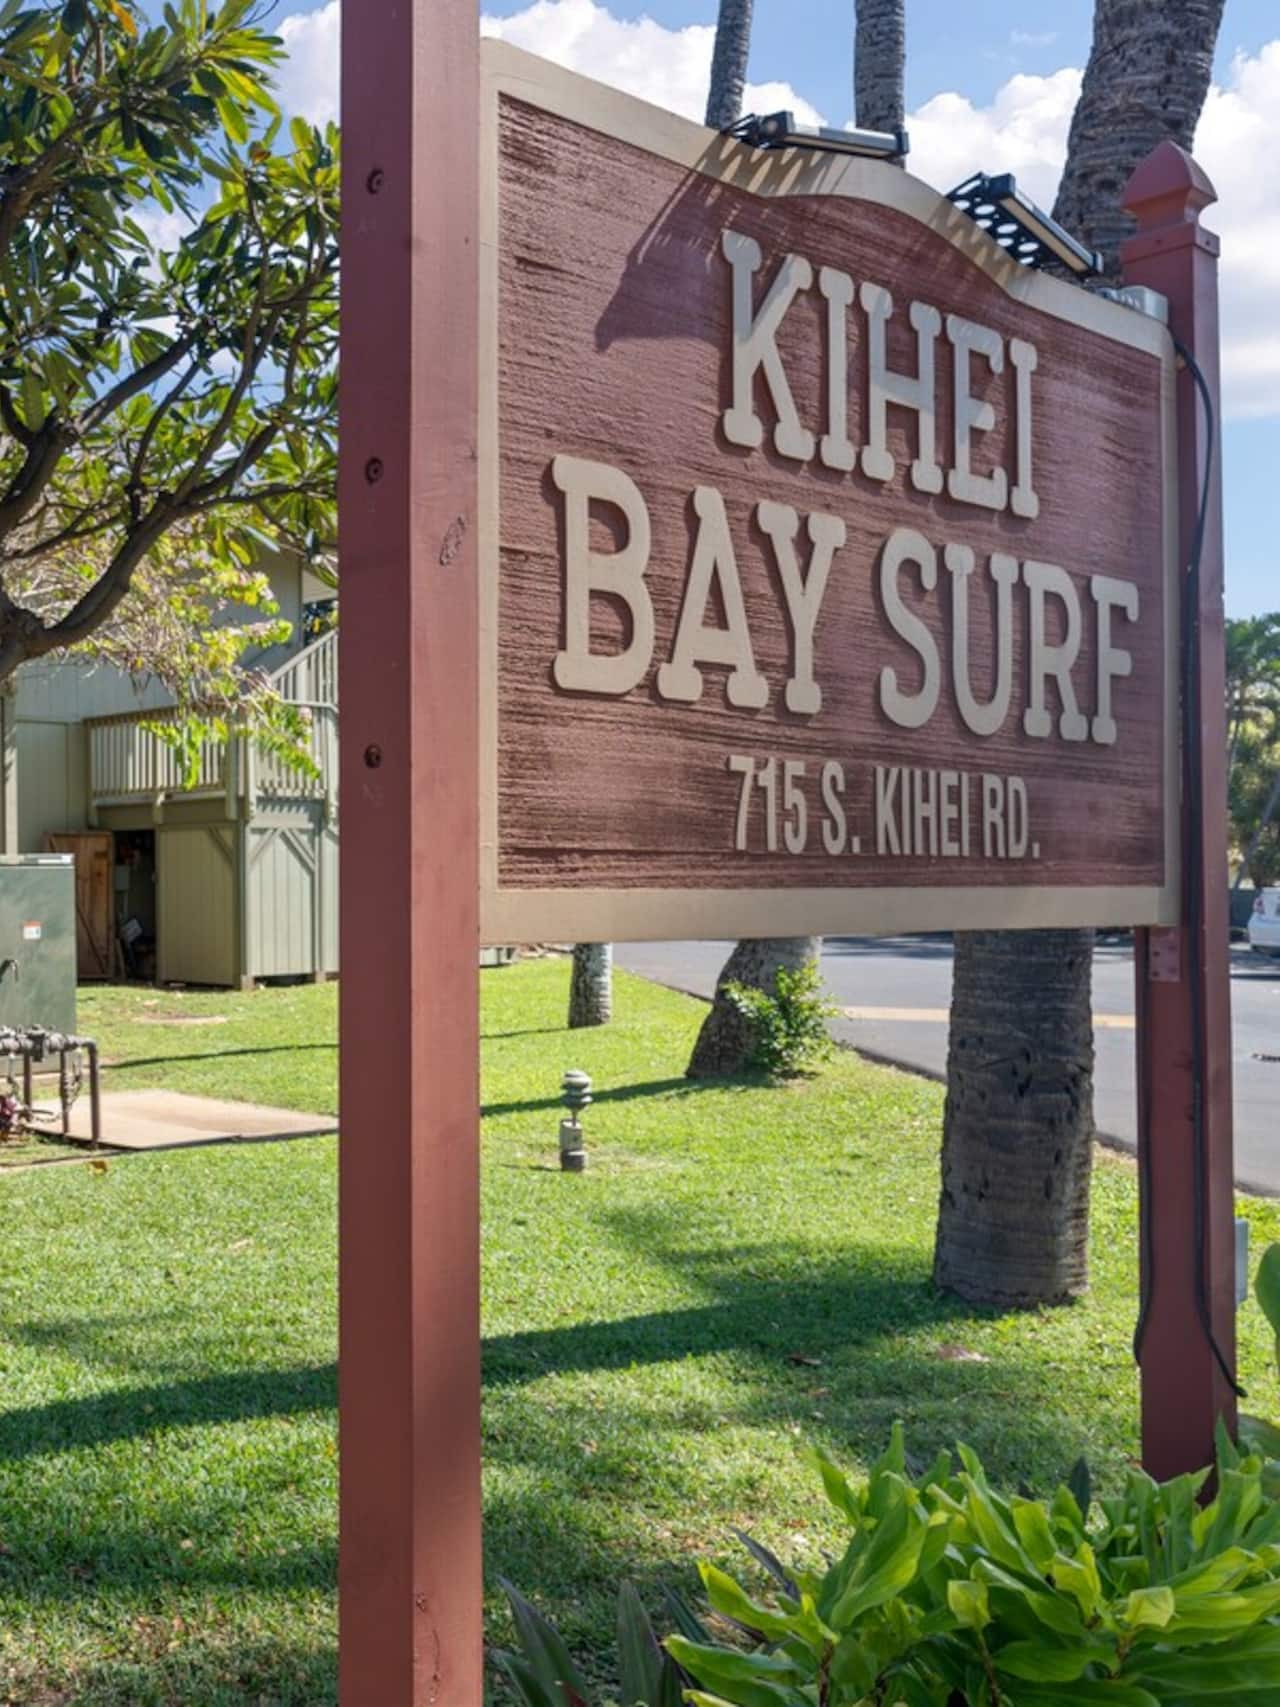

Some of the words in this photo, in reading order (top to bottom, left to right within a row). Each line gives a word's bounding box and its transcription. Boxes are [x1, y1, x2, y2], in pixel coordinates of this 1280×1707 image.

[723, 230, 1038, 517] KIHEI
[552, 455, 846, 714] BAY
[880, 528, 1138, 743] SURF
[728, 756, 808, 854] 715
[822, 762, 860, 856] S.
[876, 767, 970, 857] KIHEI
[984, 775, 1039, 859] RD.
